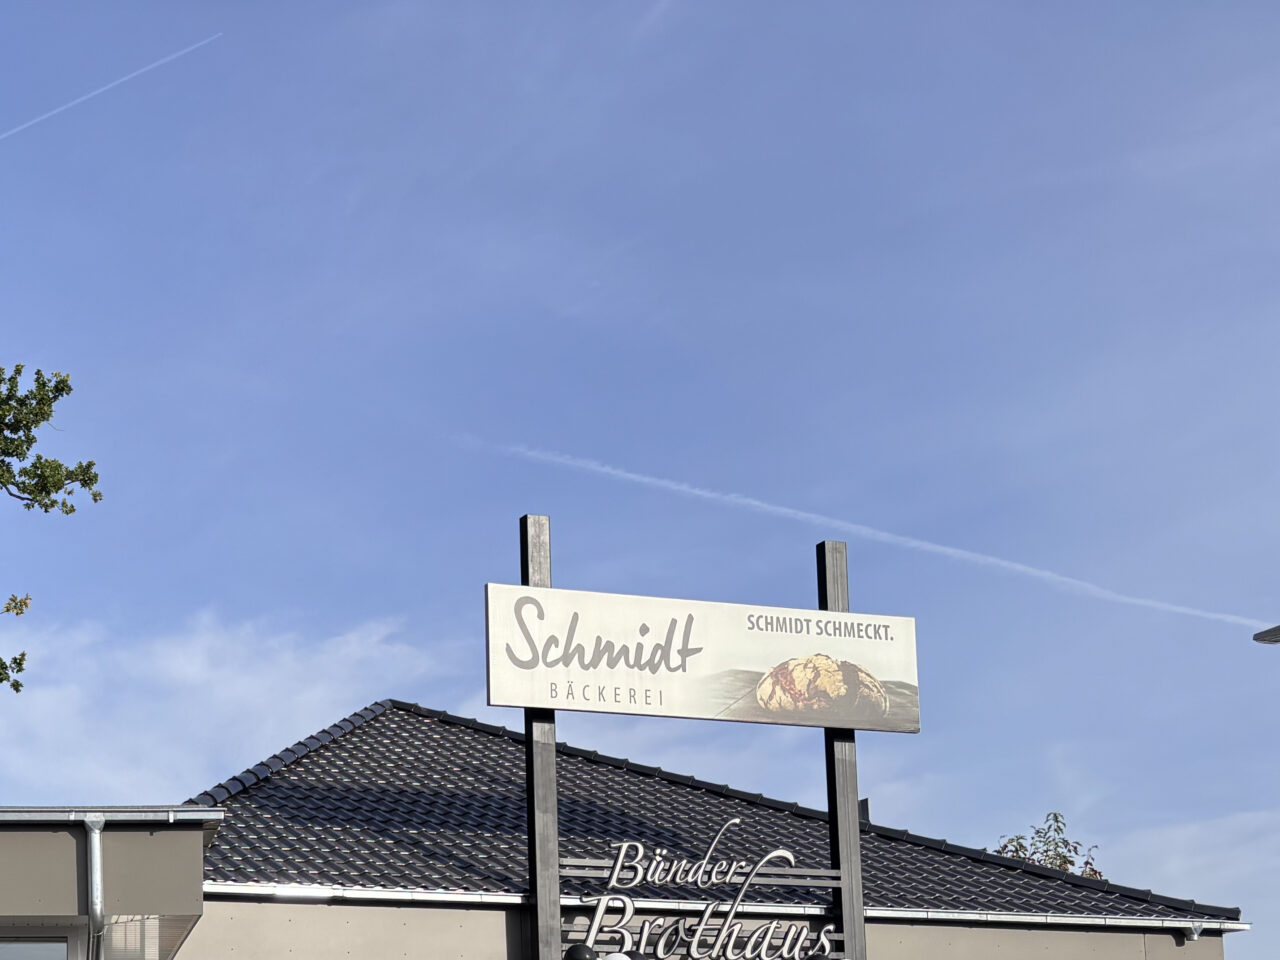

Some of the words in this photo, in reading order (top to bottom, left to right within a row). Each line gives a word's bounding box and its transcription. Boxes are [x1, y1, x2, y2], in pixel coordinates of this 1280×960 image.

[505, 596, 704, 674] Schmidt
[747, 614, 813, 636] SCHMIDT
[815, 619, 895, 641] SCHMECKT.
[549, 679, 664, 707] BÄCKEREI
[608, 818, 746, 889] Bünder
